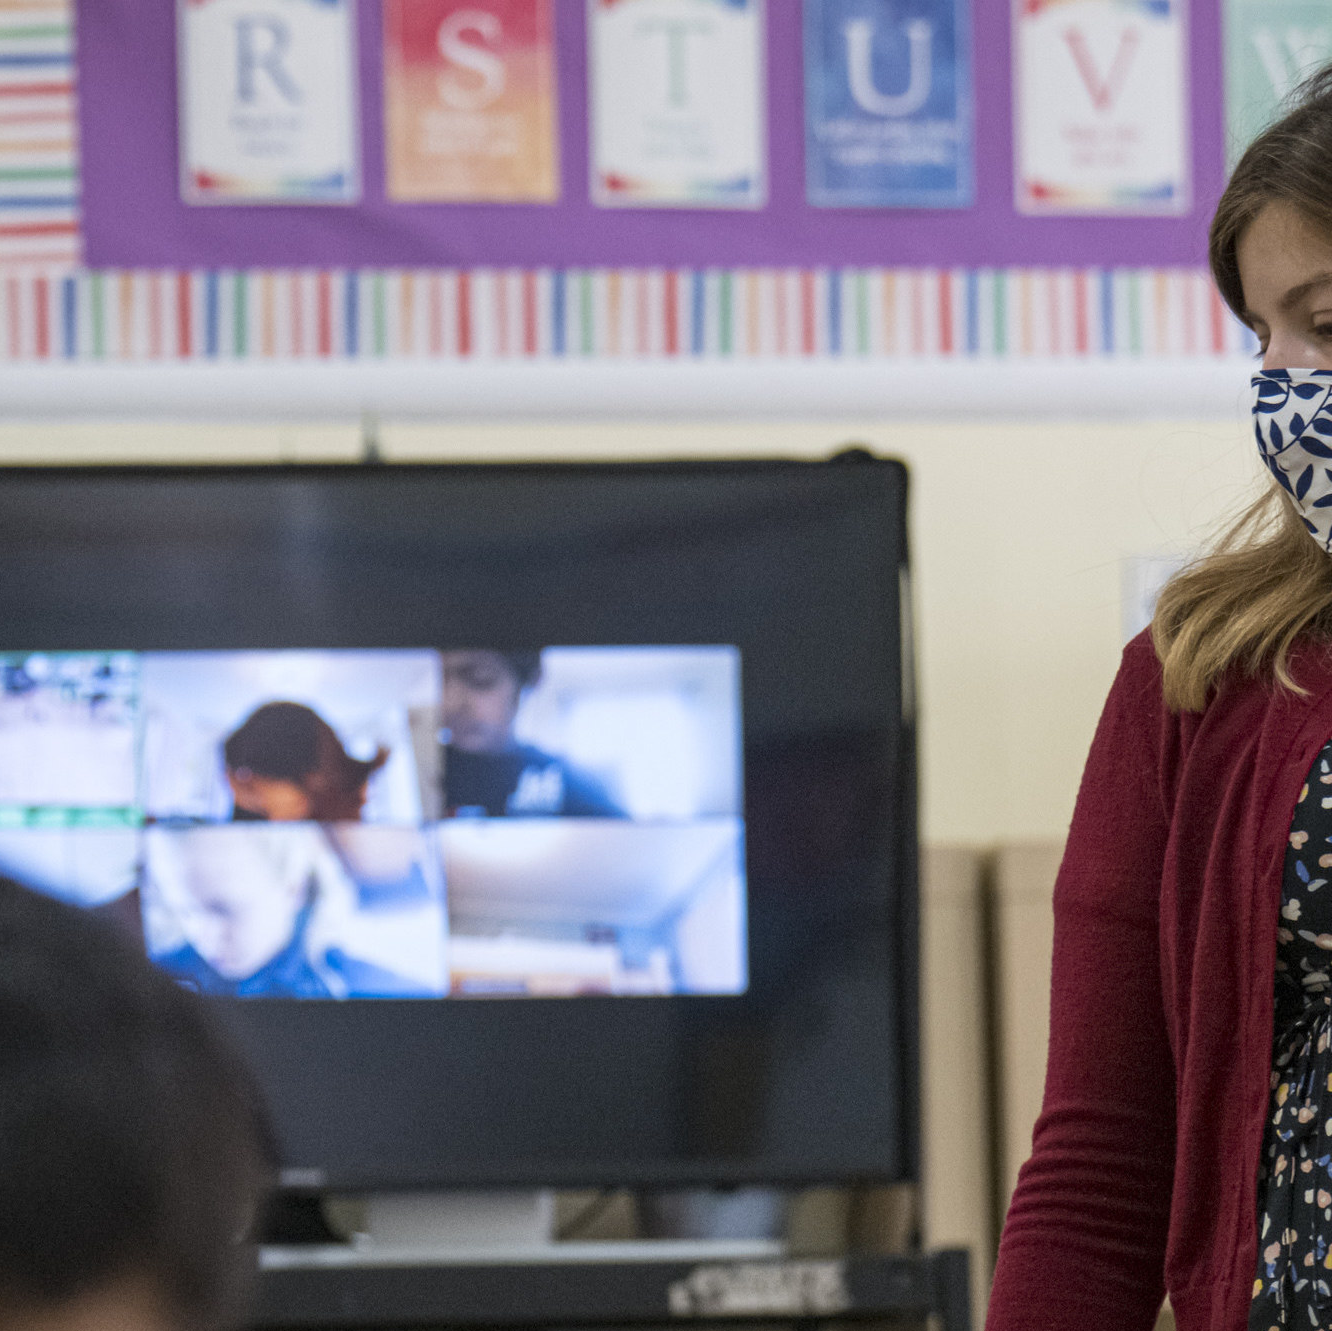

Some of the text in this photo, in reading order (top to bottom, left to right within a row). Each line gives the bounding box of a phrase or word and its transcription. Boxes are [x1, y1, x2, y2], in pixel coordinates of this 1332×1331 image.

[233, 14, 307, 106] R
[436, 8, 506, 111] S
[632, 16, 716, 107] T
[845, 18, 934, 117] U
[1063, 25, 1141, 112] V
